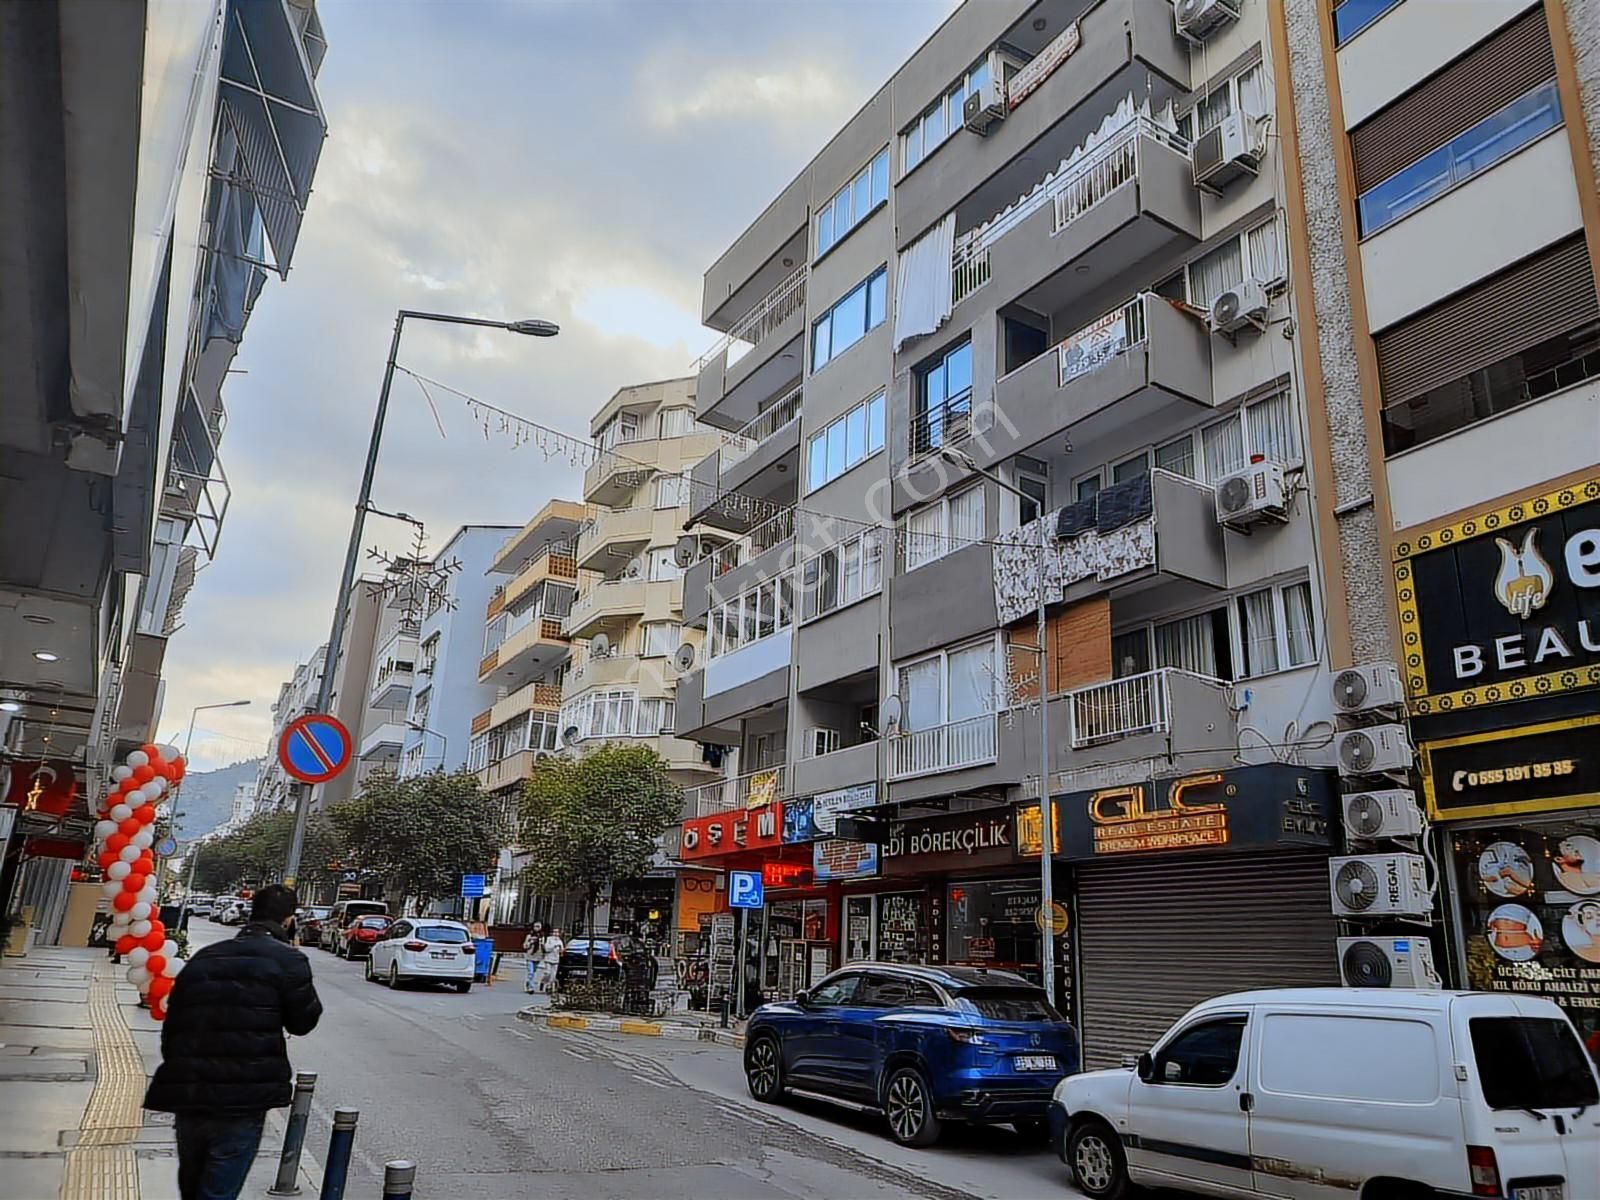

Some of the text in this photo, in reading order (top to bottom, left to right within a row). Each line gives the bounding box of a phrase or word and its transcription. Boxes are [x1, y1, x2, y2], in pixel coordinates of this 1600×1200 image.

[1511, 585, 1543, 618] life
[1087, 773, 1225, 824] GLC
[911, 820, 1011, 855] BÖREKÇİLİK
[1097, 816, 1217, 838] REAL ESTATE
[1387, 859, 1400, 904] REGAL
[1545, 980, 1589, 993] ANALİZİ
